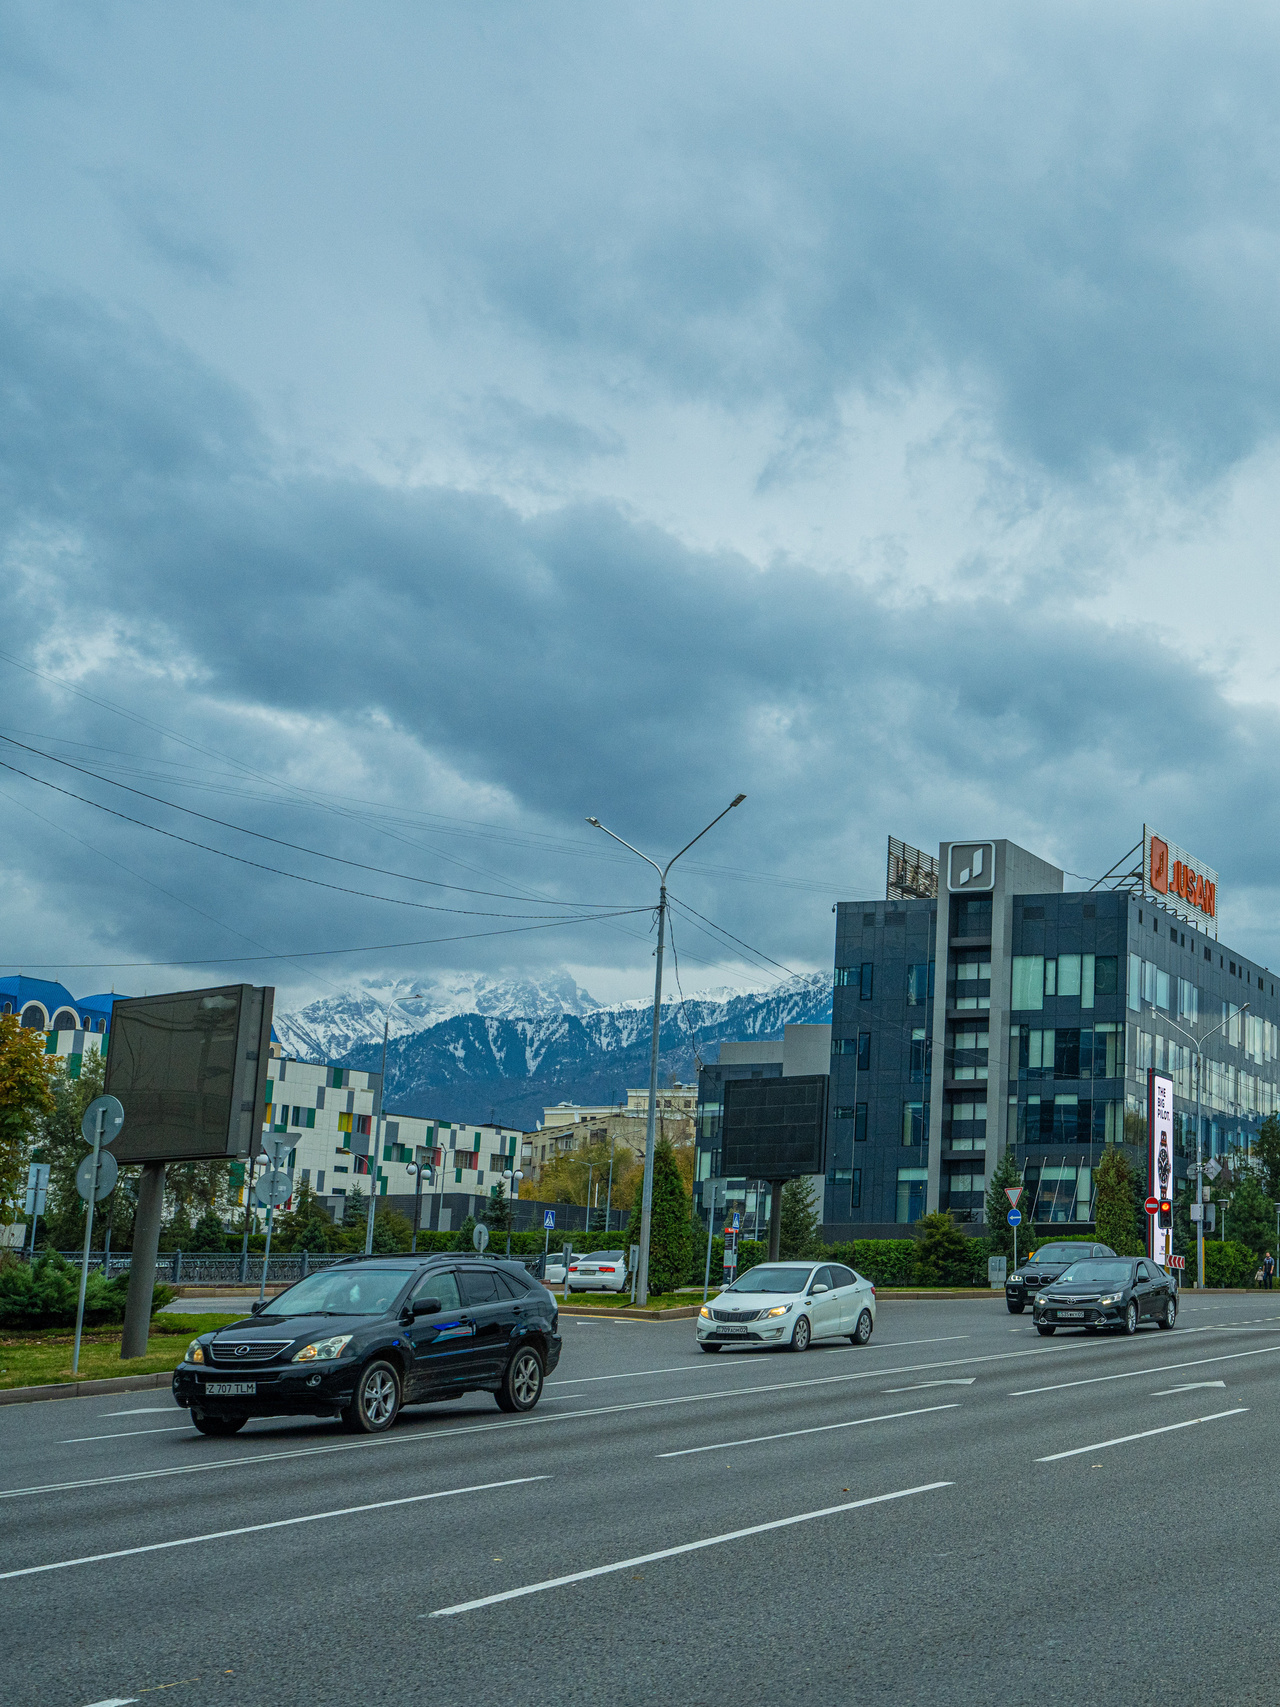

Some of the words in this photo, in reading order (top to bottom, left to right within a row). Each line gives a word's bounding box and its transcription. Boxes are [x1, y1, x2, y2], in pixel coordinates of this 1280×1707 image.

[1169, 860, 1215, 917] JUSAN
[1158, 1086, 1166, 1097] THE
[217, 1384, 232, 1394] 707
[234, 1384, 254, 1393] TLM
